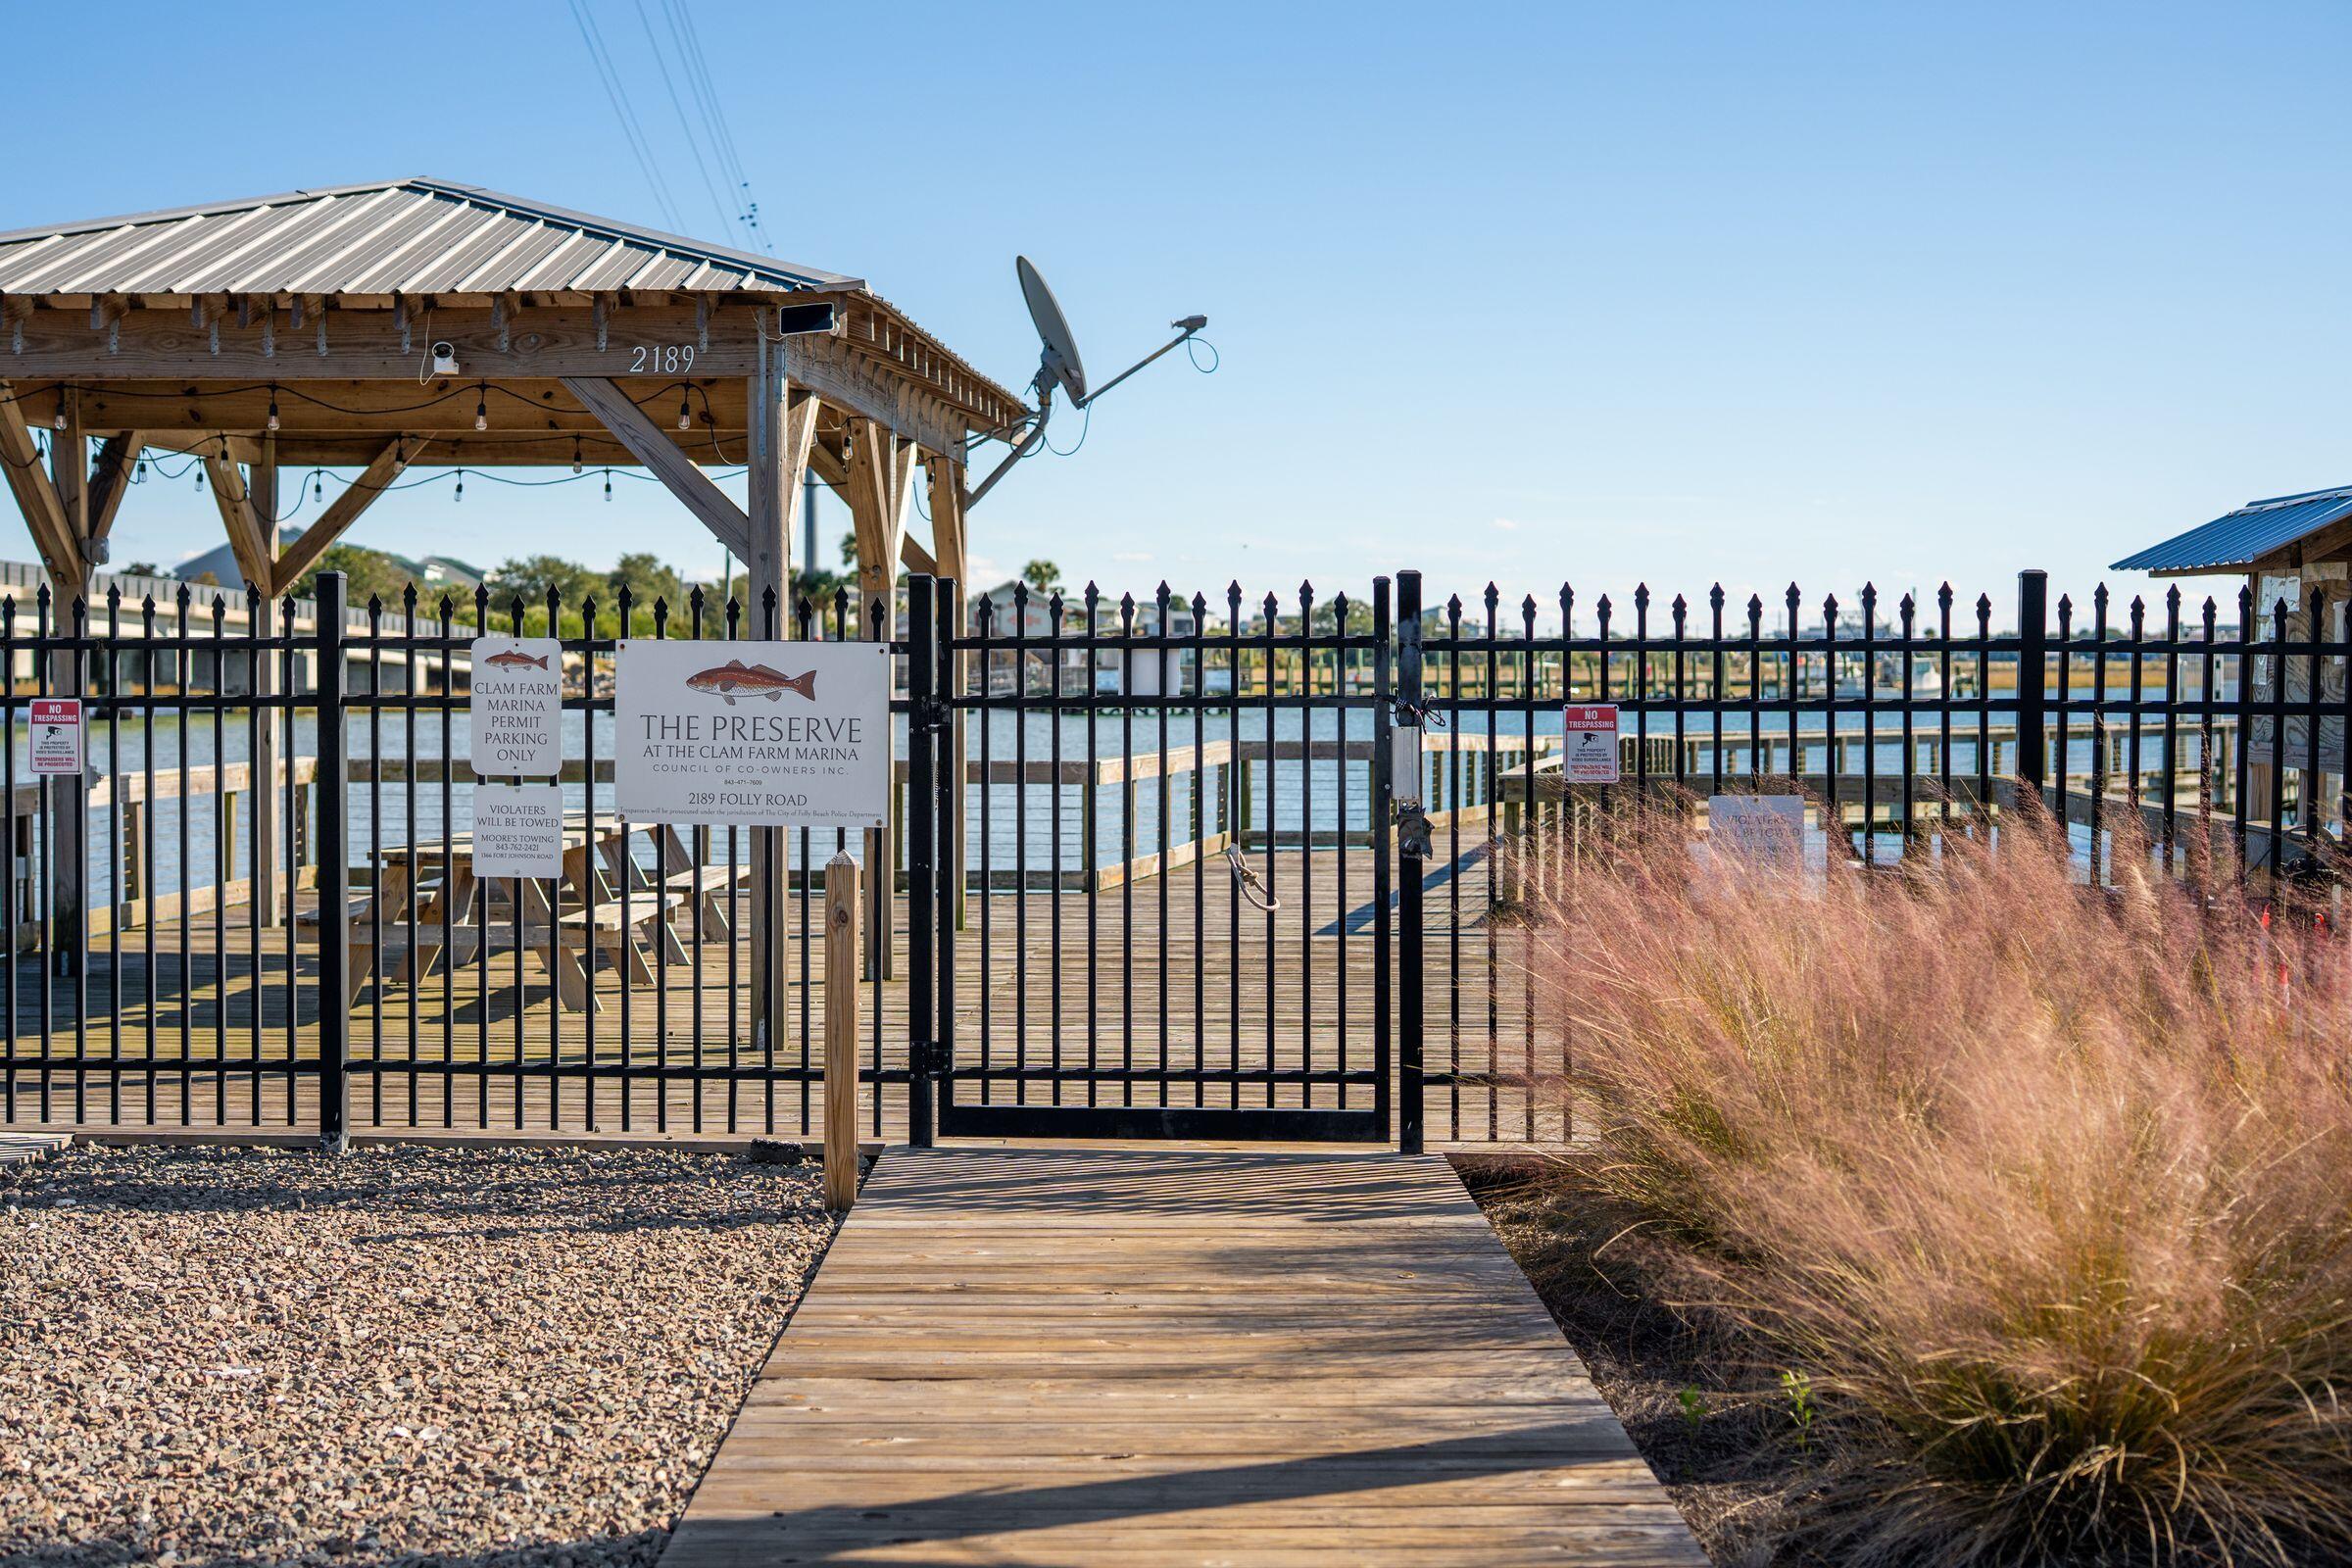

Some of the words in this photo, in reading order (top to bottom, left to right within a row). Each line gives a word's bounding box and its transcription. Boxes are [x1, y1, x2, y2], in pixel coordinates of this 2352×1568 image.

[629, 345, 695, 373] 2189
[474, 682, 514, 695] CLAM
[519, 683, 558, 696] FARM
[49, 705, 62, 714] NO
[487, 699, 545, 712] MARINA
[1585, 710, 1598, 720] NO
[491, 715, 541, 728] PERMIT
[640, 714, 700, 741] THE
[712, 715, 862, 743] PRESERVE
[485, 732, 548, 746] PARKING
[497, 749, 537, 761] ONLY
[643, 745, 664, 758] AT
[666, 745, 695, 759] THE
[700, 746, 743, 760] CLAM
[749, 747, 790, 760] FARM
[795, 747, 858, 761] MARINA
[653, 763, 709, 773] COUNCIL
[714, 764, 731, 773] OF
[737, 765, 816, 775] CO-OWNERS
[822, 766, 850, 775] INC.
[688, 792, 715, 805] 2189
[720, 793, 761, 806] FOLLY
[765, 794, 808, 807] ROAD
[489, 805, 546, 814] VIOLATERS
[849, 810, 882, 819] Department
[477, 817, 502, 826] WILL
[519, 818, 559, 827] TOWED
[519, 835, 554, 844] TOWING
